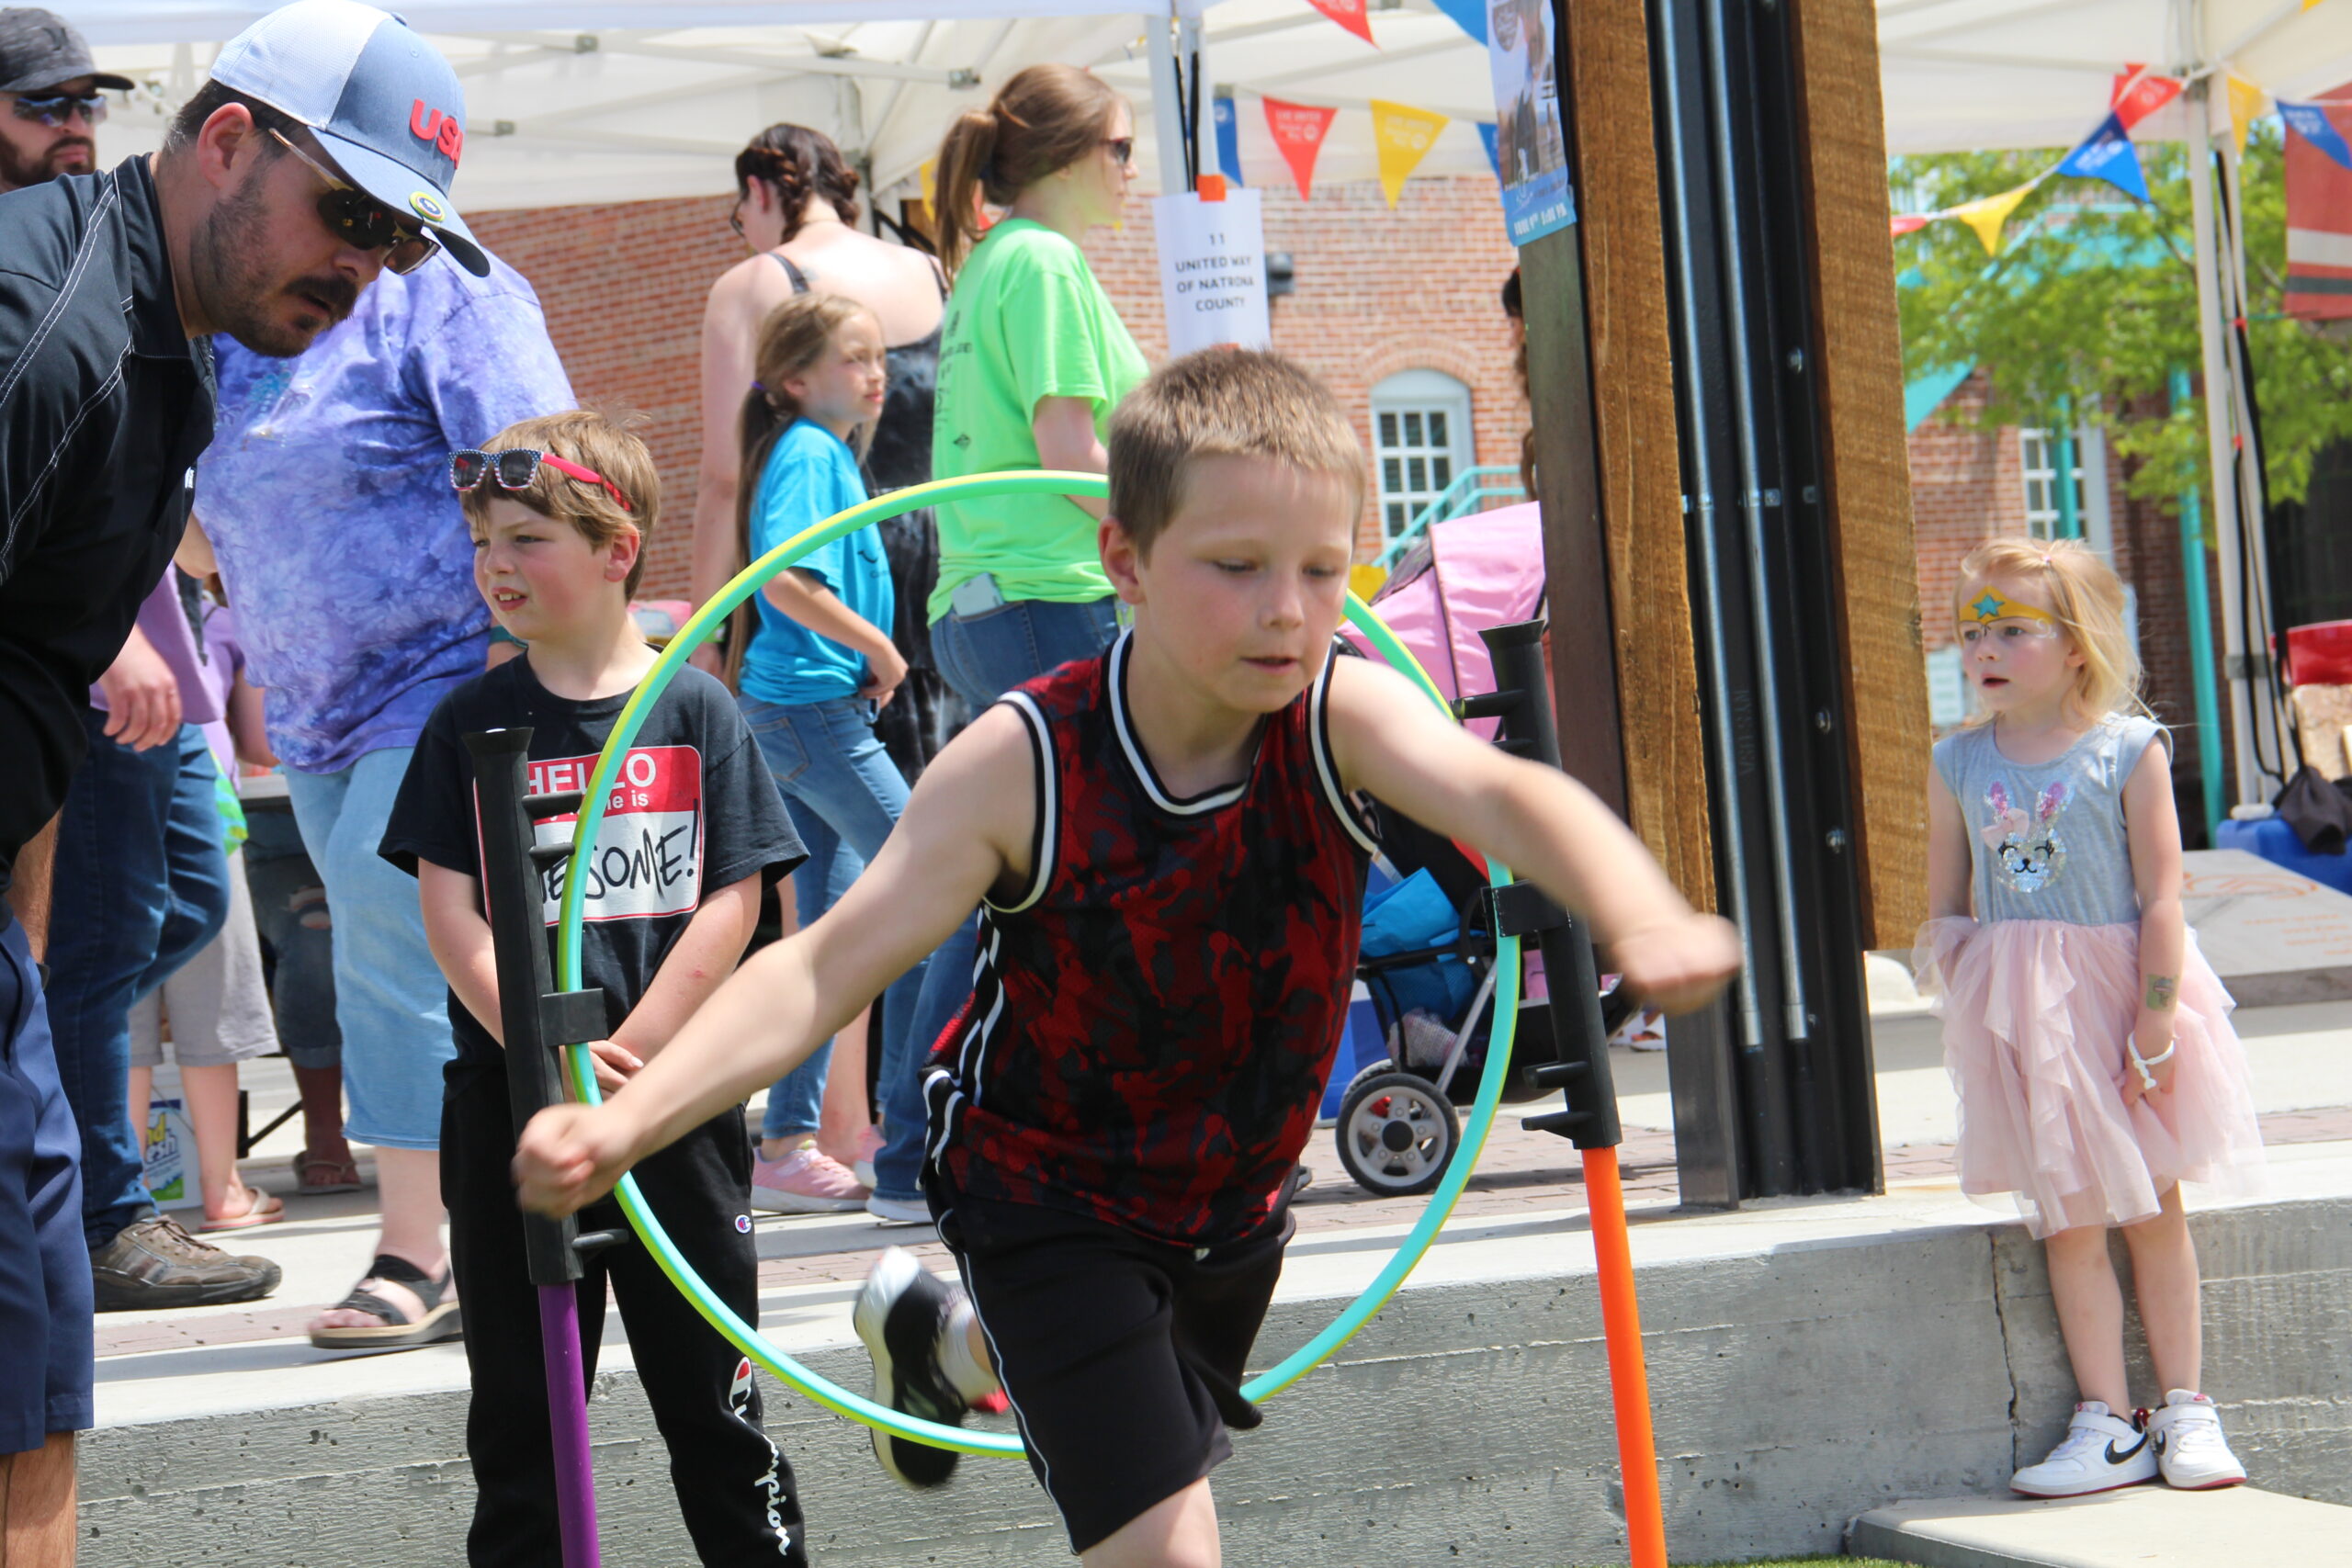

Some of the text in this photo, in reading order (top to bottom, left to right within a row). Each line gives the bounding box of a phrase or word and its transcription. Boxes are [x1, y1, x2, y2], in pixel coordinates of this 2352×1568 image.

[410, 97, 463, 170] USA
[1175, 255, 1252, 273] UNITED WAY
[1177, 276, 1255, 293] OF NATRONA
[1195, 298, 1245, 311] COUNTY
[528, 753, 656, 795] HELO
[631, 789, 649, 807] is
